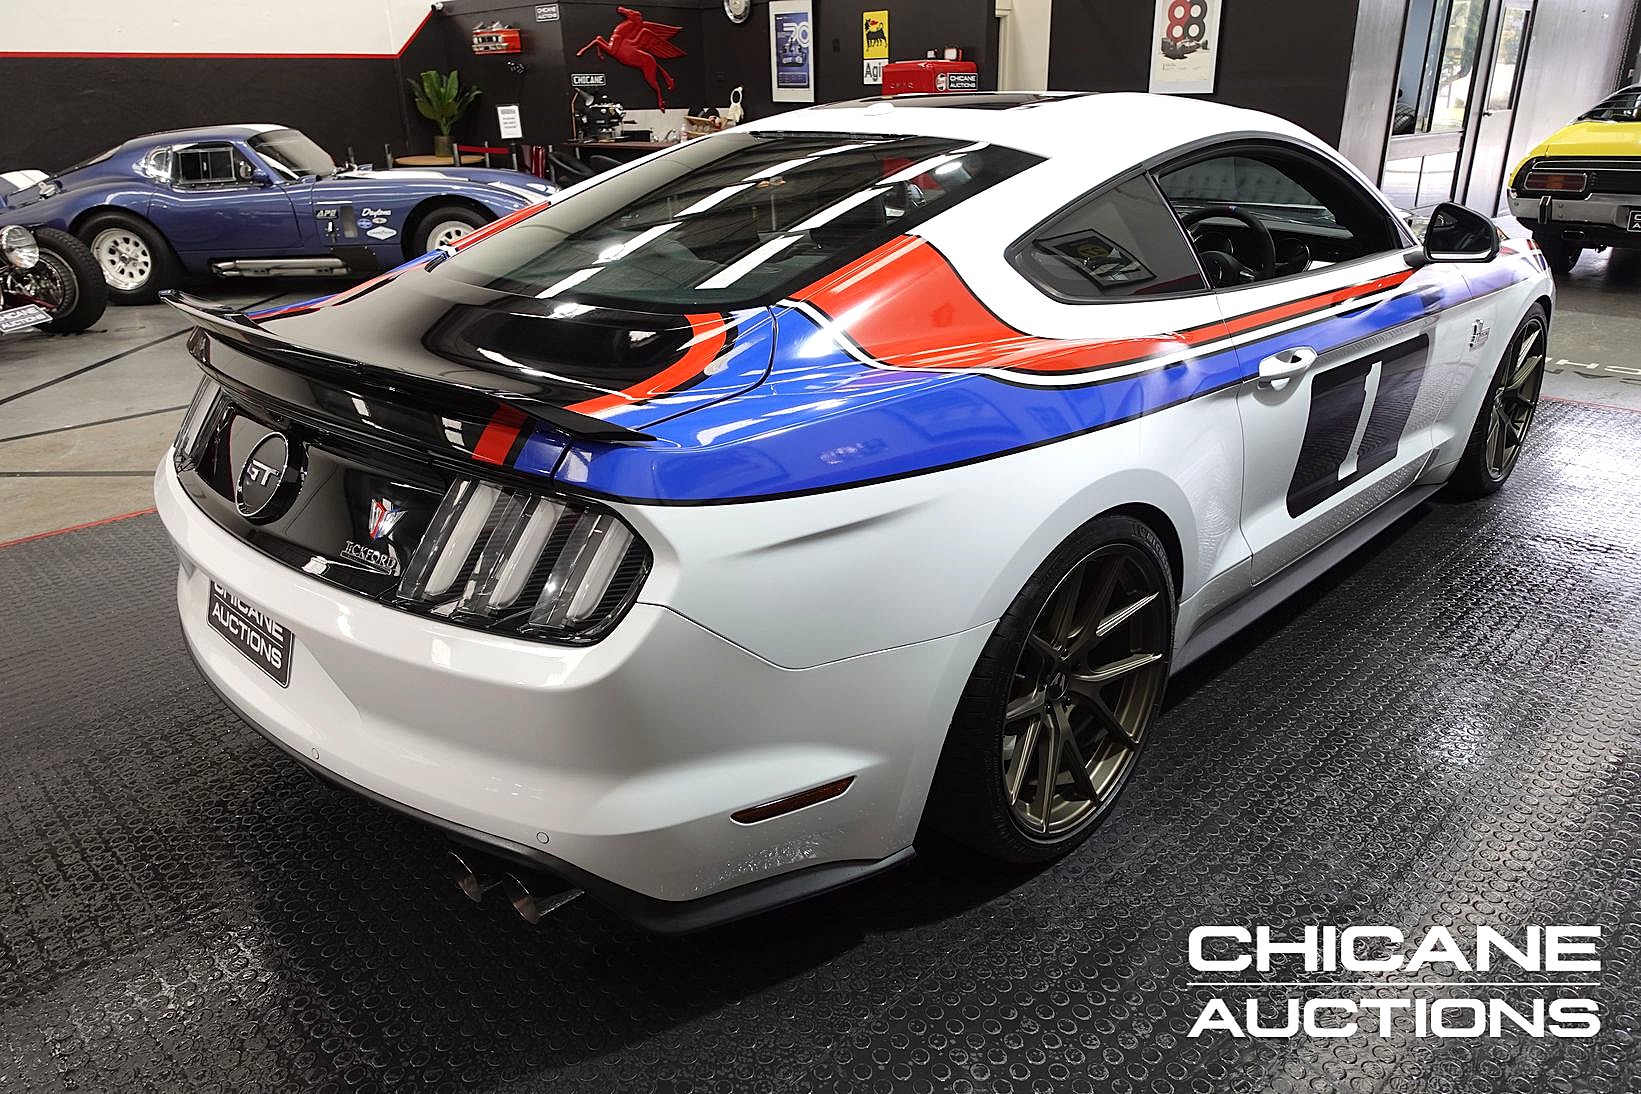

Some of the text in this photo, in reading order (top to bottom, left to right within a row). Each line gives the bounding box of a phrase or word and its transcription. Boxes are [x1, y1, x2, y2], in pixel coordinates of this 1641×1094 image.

[1166, 0, 1208, 43] 88
[783, 22, 809, 48] 70
[573, 75, 604, 84] CHICANE
[864, 62, 882, 81] Agi
[0, 307, 40, 321] HICANE
[1337, 360, 1383, 482] 1
[247, 459, 280, 486] GT
[212, 601, 283, 670] AUCTIONS
